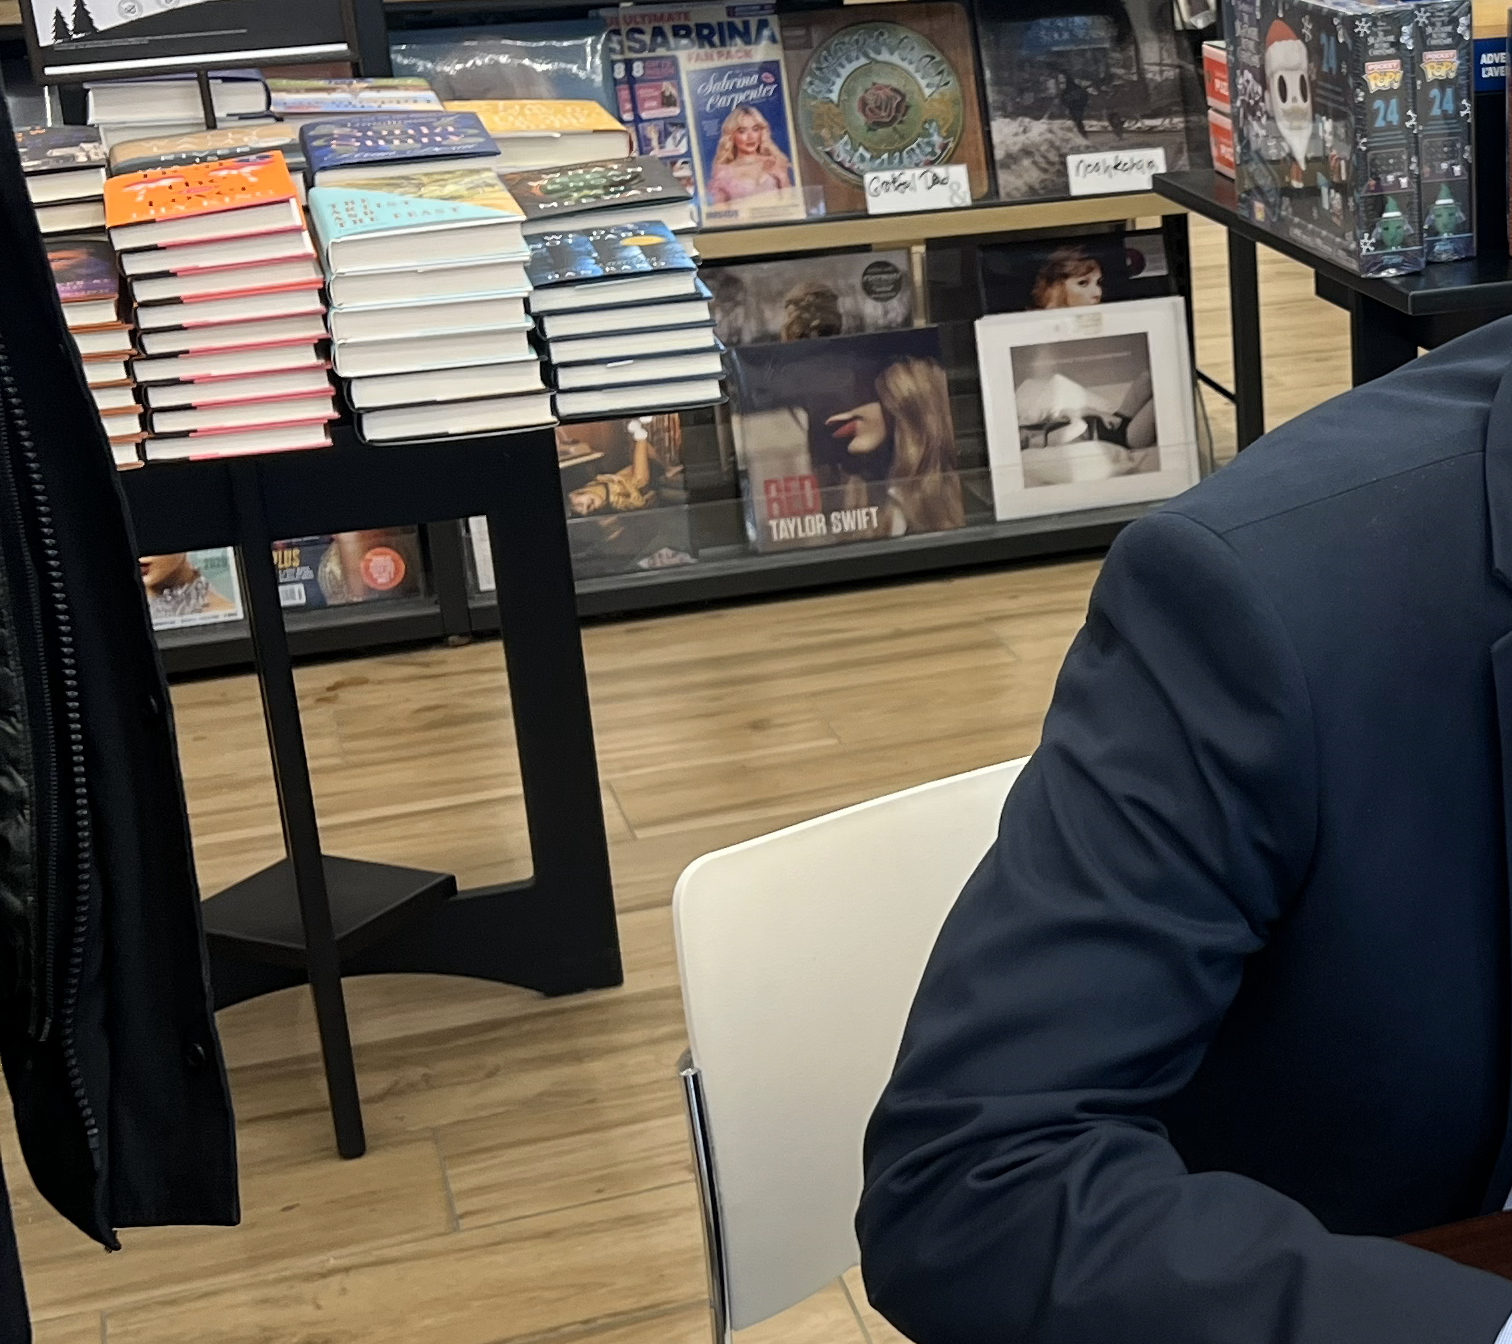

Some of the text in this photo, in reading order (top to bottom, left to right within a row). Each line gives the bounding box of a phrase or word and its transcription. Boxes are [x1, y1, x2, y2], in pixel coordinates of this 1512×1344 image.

[625, 19, 779, 53] SABRINA
[632, 60, 644, 77] 8
[697, 70, 760, 95] Sabrina
[1365, 70, 1403, 92] POP!
[1421, 59, 1459, 81] POP!
[706, 83, 779, 112] Carpenter
[1429, 88, 1455, 116] 24
[1373, 99, 1399, 127] 24
[764, 475, 822, 518] RED
[769, 507, 879, 542] TAYLOR SWIFT
